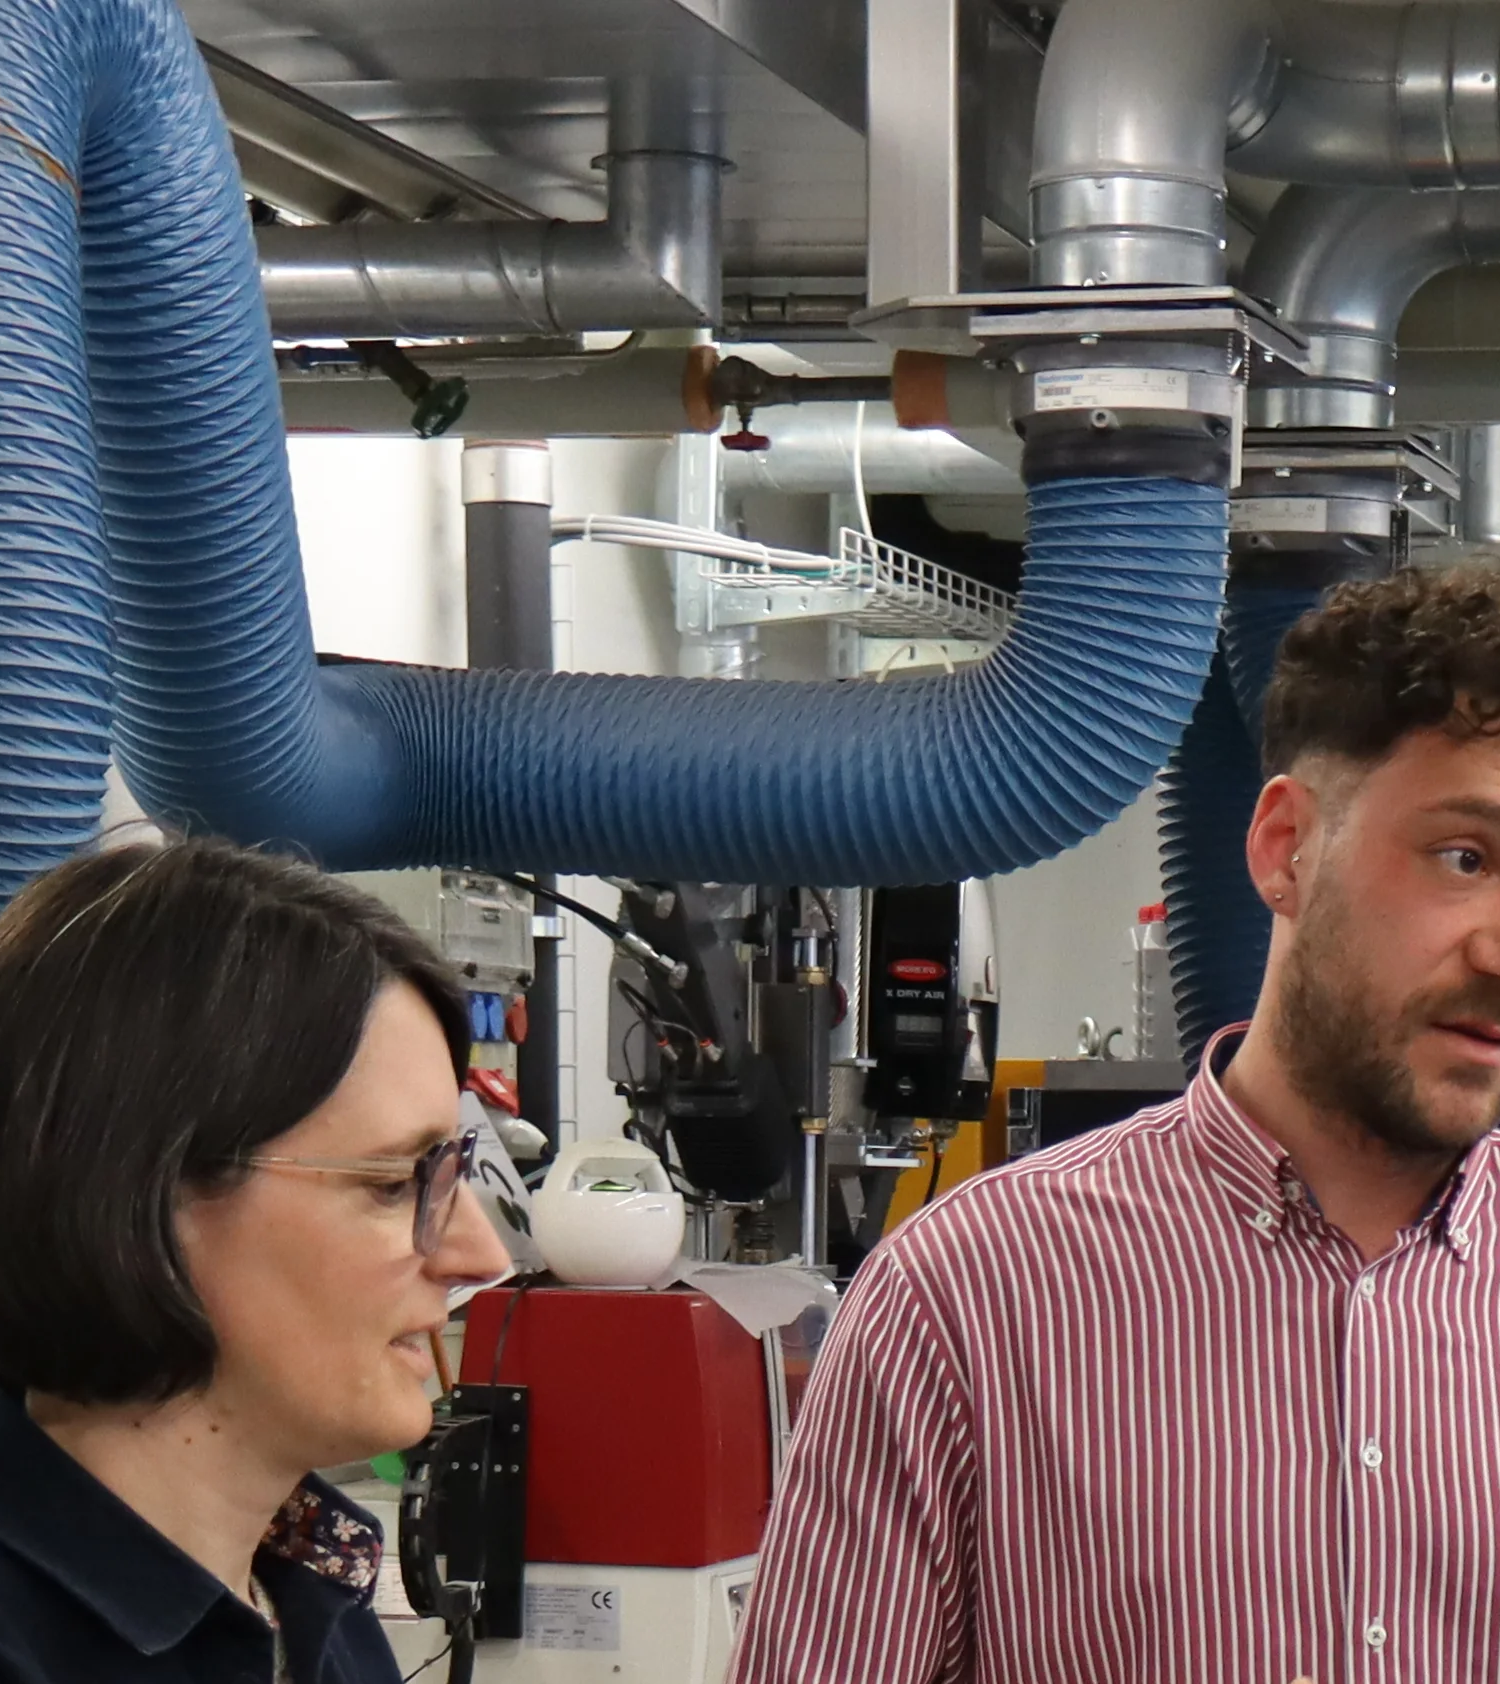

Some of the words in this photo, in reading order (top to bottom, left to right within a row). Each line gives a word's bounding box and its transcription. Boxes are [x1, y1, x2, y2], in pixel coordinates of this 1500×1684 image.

[896, 989, 921, 998] DRY
[924, 990, 946, 1000] AIR
[591, 1590, 613, 1610] CE
